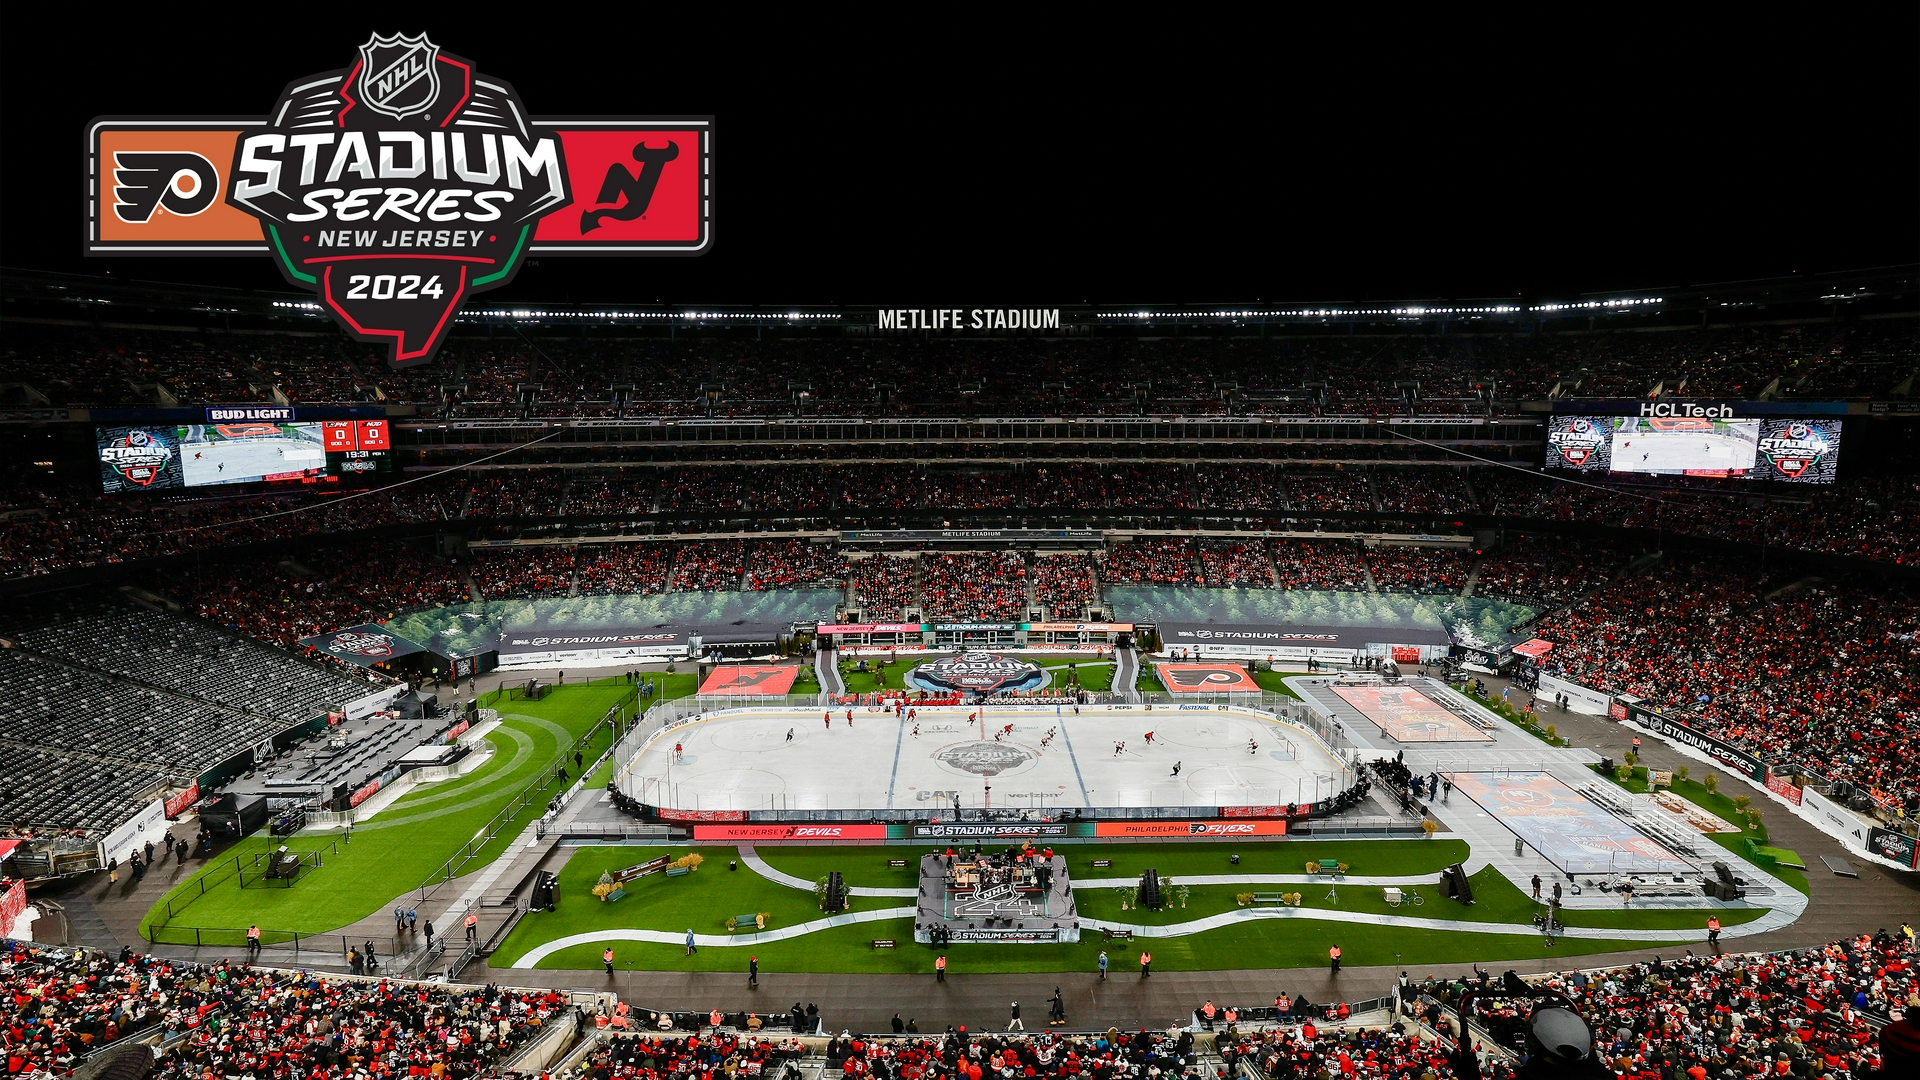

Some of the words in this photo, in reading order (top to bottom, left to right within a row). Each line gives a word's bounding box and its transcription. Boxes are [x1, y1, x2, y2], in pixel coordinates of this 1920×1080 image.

[878, 309, 964, 329] METLIFE
[970, 308, 1060, 329] STADIUM
[212, 410, 245, 420] BUD
[246, 410, 289, 418] LIGHT
[1640, 403, 1733, 418] HCLTech
[336, 430, 346, 440] 0
[369, 428, 378, 438] 0
[101, 447, 172, 460] STADIUM
[550, 636, 618, 644] STADIUM
[918, 662, 1043, 672] STADIUM
[349, 704, 366, 715] verizon
[664, 719, 688, 732] DISCOVER
[1282, 716, 1296, 726] NFP
[1664, 723, 1712, 753] STADIUM
[1711, 747, 1756, 774] SERIES
[938, 752, 1032, 760] STADIUM
[916, 790, 958, 800] CAT
[796, 828, 842, 836] DEVILS
[946, 826, 996, 835] STADIUM
[995, 826, 1040, 834] SERIES
[1207, 824, 1256, 834] FLYERS
[1874, 836, 1910, 854] STADIUM
[984, 884, 1009, 898] NHL
